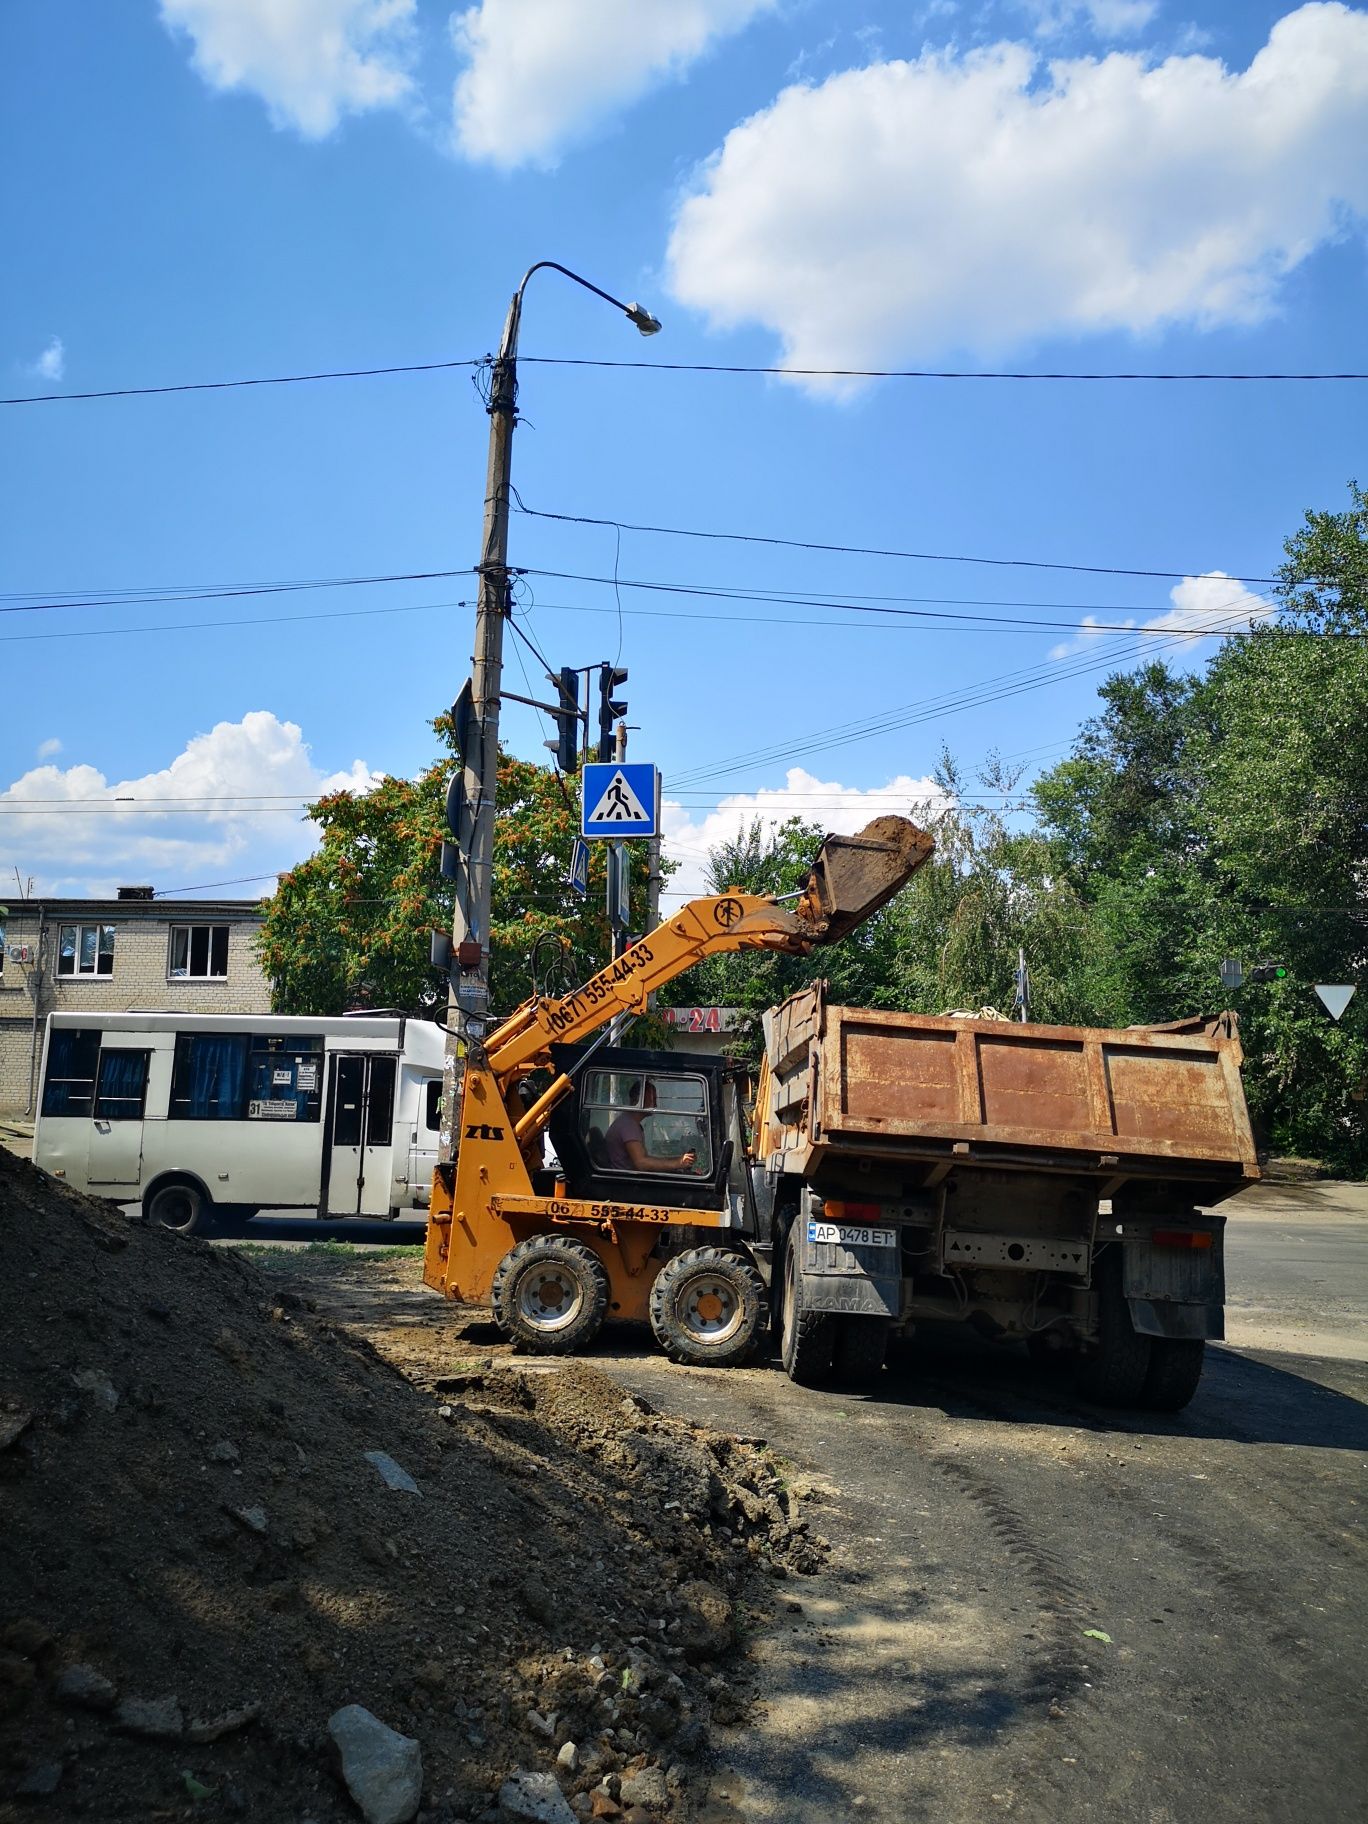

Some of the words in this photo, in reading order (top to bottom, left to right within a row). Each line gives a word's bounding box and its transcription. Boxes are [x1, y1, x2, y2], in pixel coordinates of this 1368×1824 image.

[585, 943, 654, 1005] 555-44-33
[249, 1102, 260, 1115] 31
[464, 1123, 505, 1140] zts
[816, 1226, 836, 1240] AP
[839, 1228, 870, 1243] 0478
[872, 1231, 891, 1245] ET
